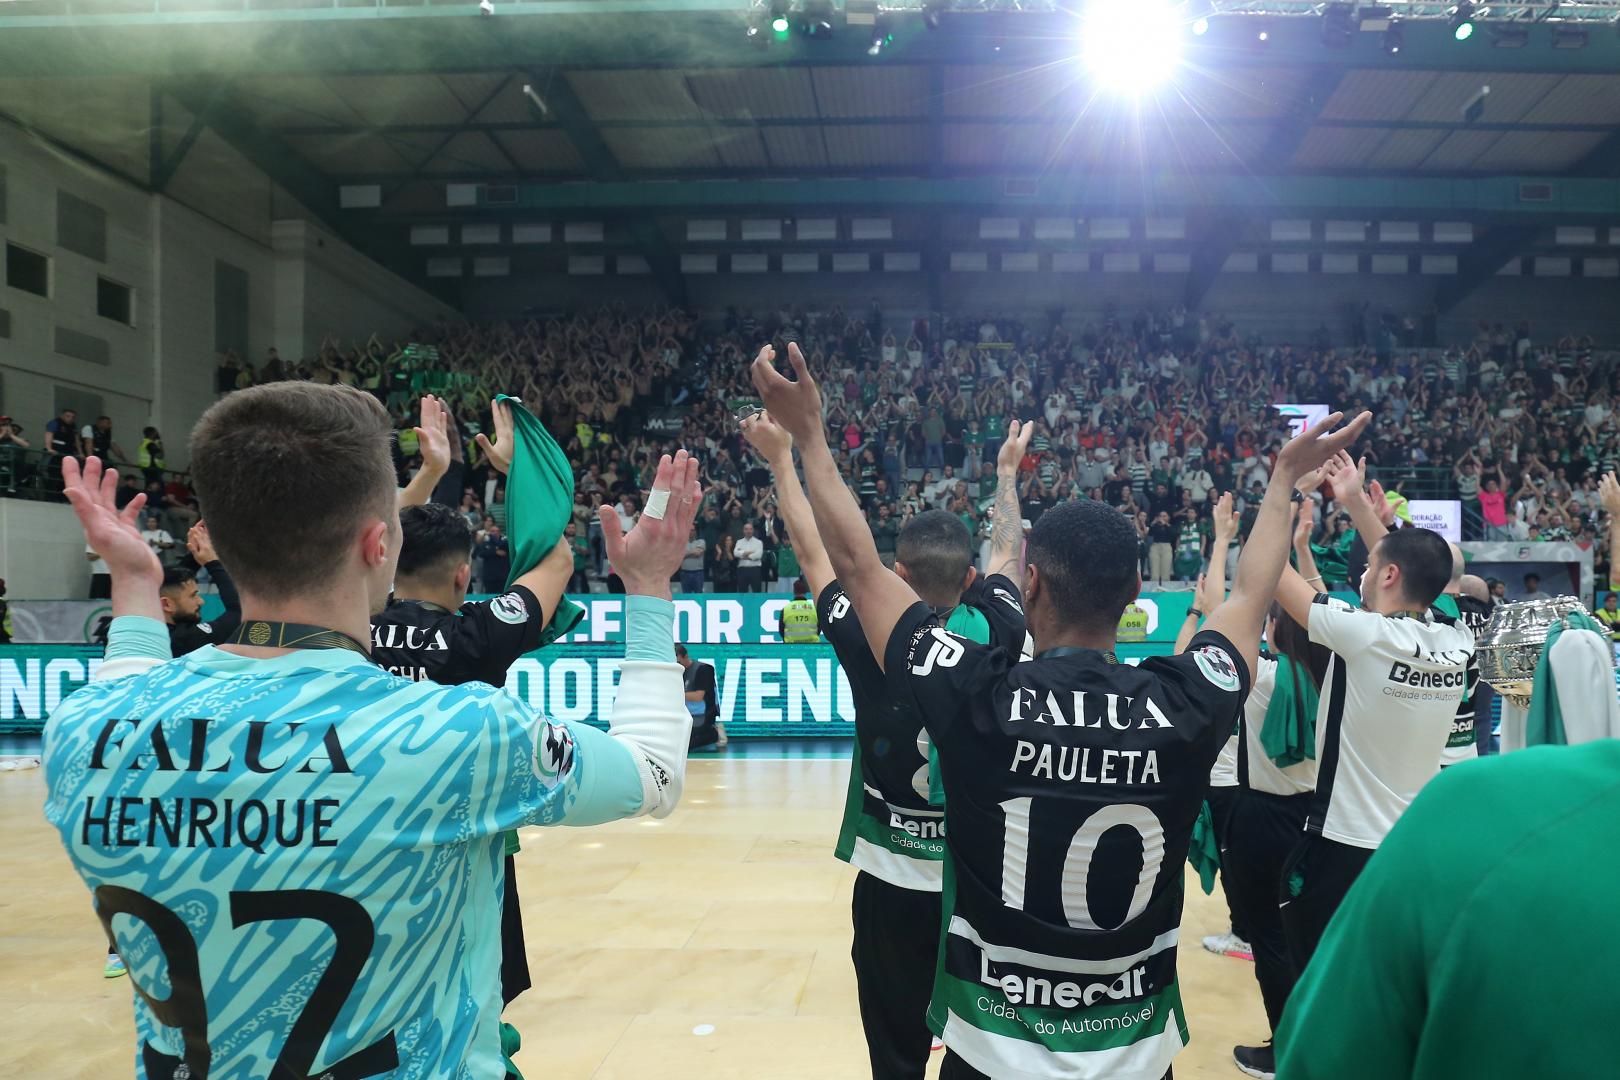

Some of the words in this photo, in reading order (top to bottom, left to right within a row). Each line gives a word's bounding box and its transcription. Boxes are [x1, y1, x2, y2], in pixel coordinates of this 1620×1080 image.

[1126, 620, 1141, 628] 058
[378, 663, 430, 682] CHA
[1382, 686, 1420, 700] Cidade
[1422, 692, 1433, 701] do
[1008, 686, 1175, 730] FALUA
[88, 718, 354, 774] FALUA
[1009, 739, 1161, 785] PAULETA
[81, 795, 340, 855] HENRIQUE
[890, 834, 927, 850] Cidade
[928, 843, 944, 852] do
[998, 796, 1166, 932] 10
[94, 884, 400, 1080] 92
[977, 997, 1030, 1029] Cida
[1034, 1019, 1056, 1035] do
[1061, 1003, 1154, 1035] Automóvel
